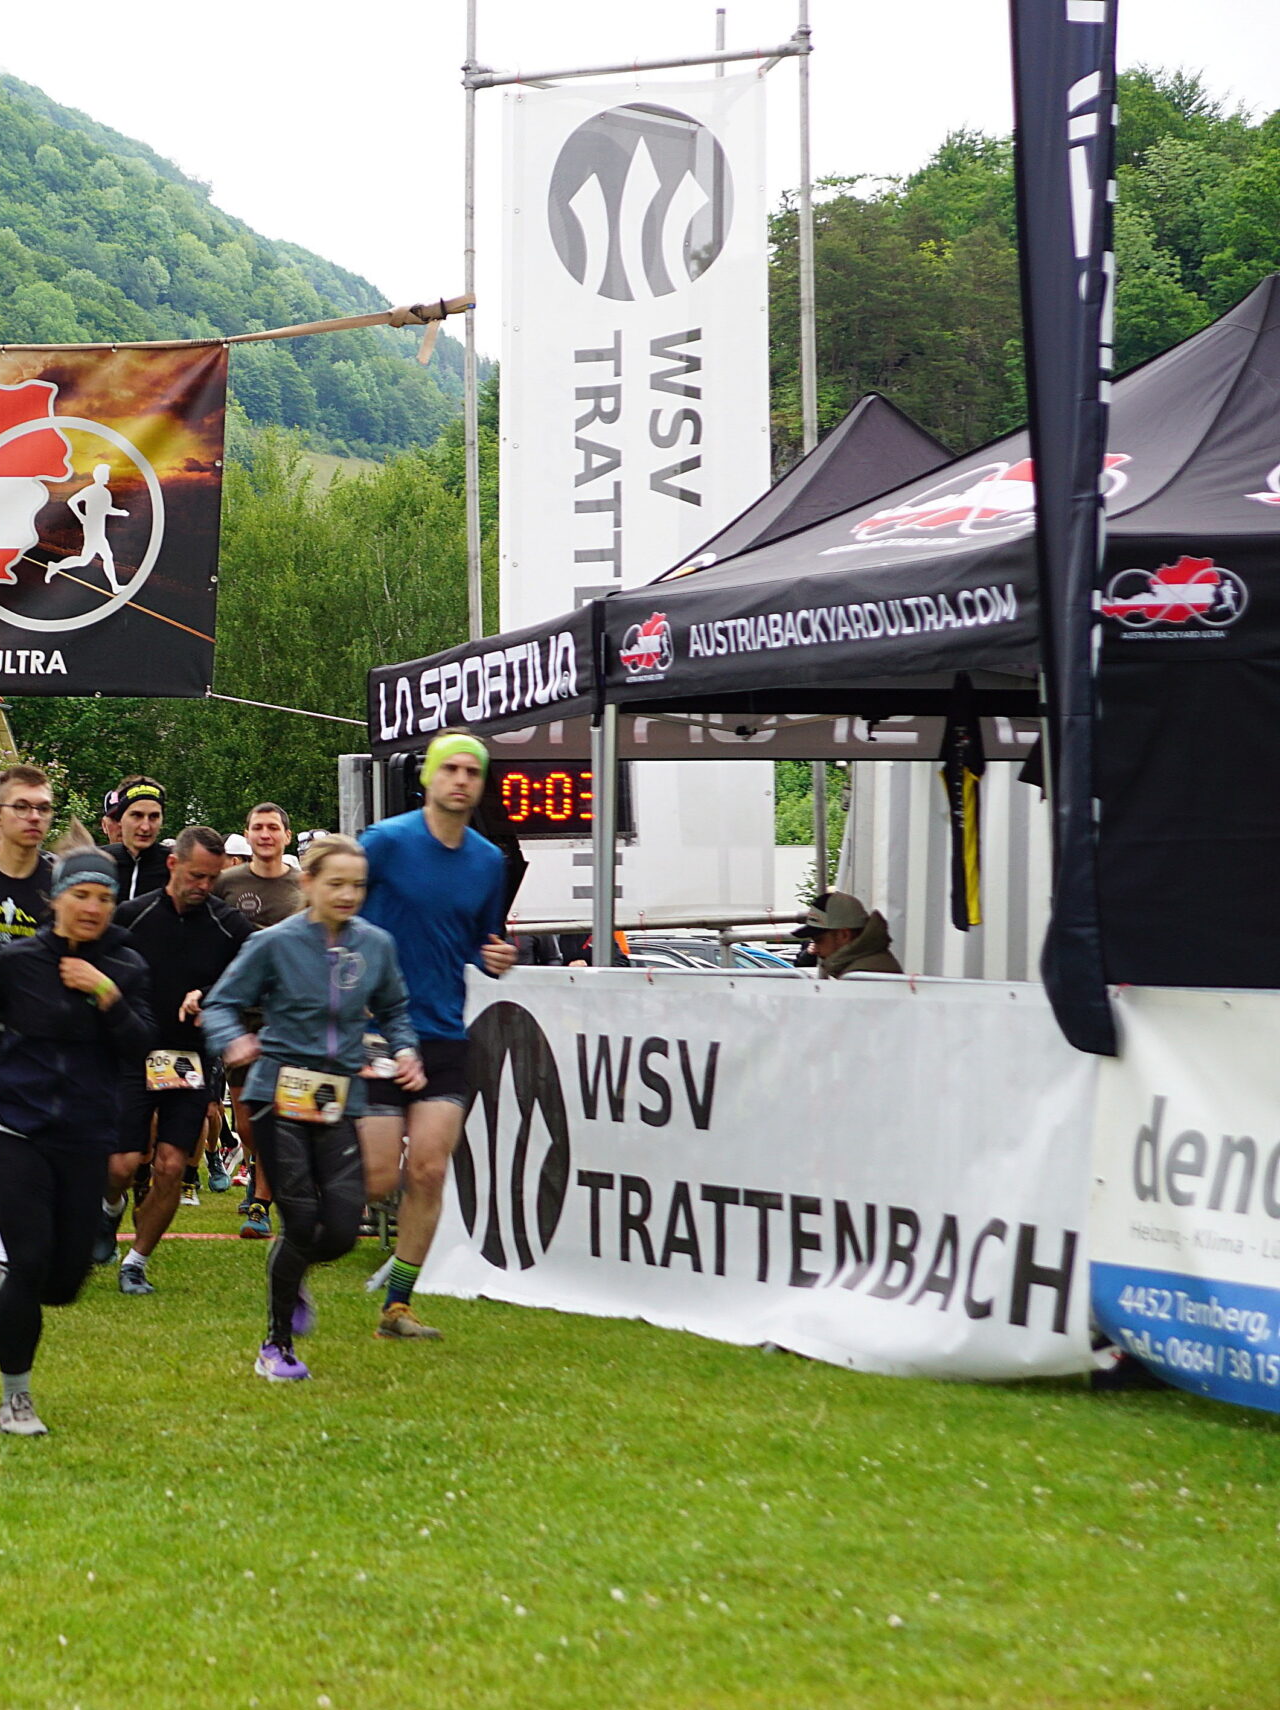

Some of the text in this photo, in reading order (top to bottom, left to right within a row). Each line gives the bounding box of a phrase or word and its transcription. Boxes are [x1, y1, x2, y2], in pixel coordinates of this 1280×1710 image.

[649, 327, 702, 507] WSV
[573, 329, 623, 604] TRATT
[688, 584, 1018, 658] AUSTRIABACKYARDULTRA.COM
[379, 677, 414, 741] LA
[147, 1055, 170, 1068] 206
[577, 1033, 720, 1131] WSV
[577, 1169, 1078, 1335] TRATTENBACH
[1118, 1285, 1172, 1320] 4452
[1227, 1347, 1253, 1381] 38
